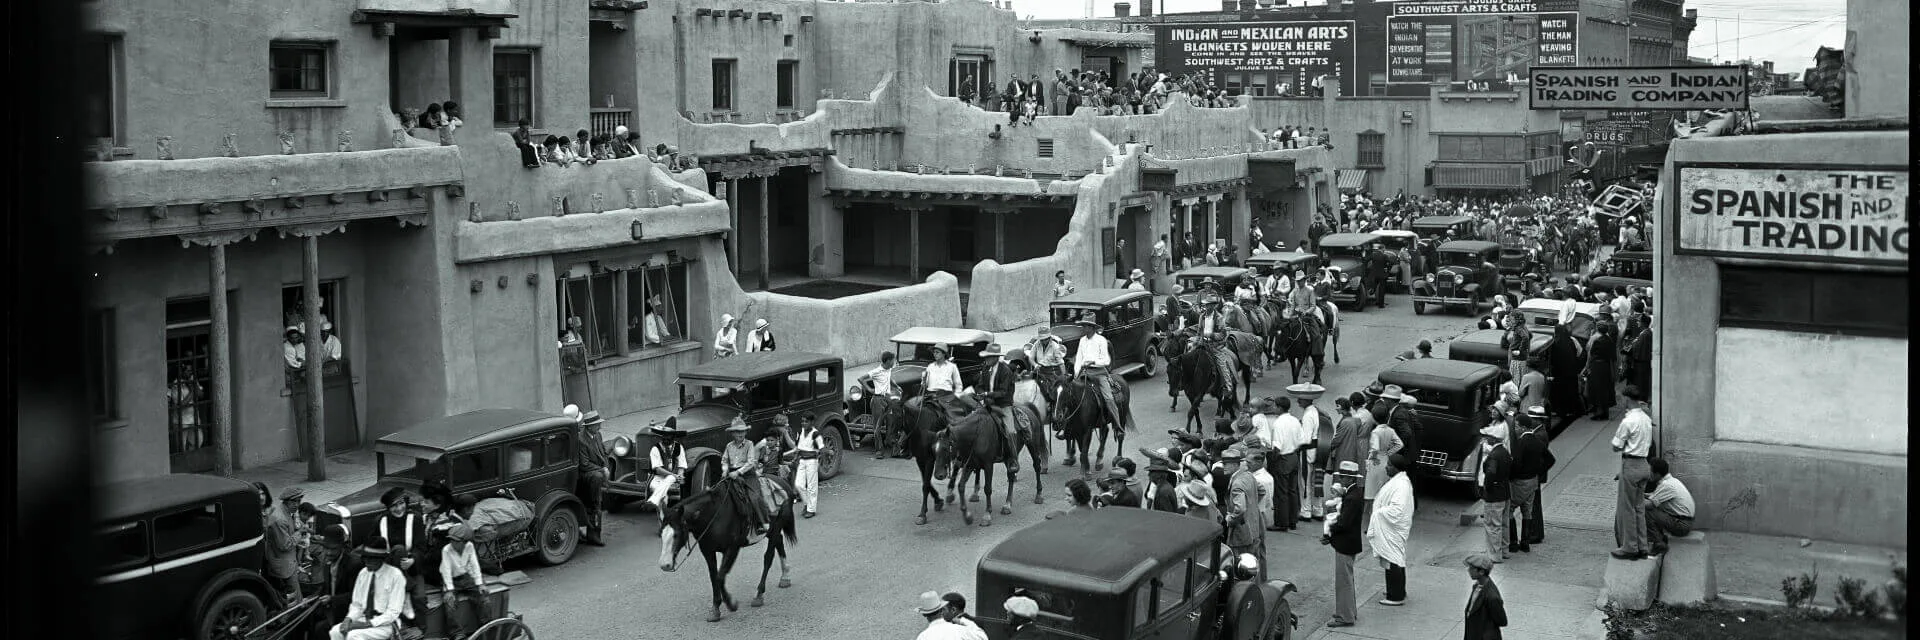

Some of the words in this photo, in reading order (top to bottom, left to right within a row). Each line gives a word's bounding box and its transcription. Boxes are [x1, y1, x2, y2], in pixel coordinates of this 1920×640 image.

[1398, 5, 1459, 14] SOUTHWEST
[1461, 4, 1489, 12] ARTS
[1491, 4, 1499, 12] &
[1500, 3, 1537, 12] CRAFTS
[1390, 22, 1409, 30] WATCH
[1410, 22, 1423, 30] THE
[1541, 20, 1567, 28] WATCH
[1240, 27, 1303, 40] MEXICAN
[1307, 26, 1348, 39] ARTS
[1541, 31, 1556, 40] THE
[1556, 31, 1572, 40] MAN
[1183, 42, 1248, 52] BLANKETS
[1251, 41, 1292, 51] WOVEN
[1296, 41, 1332, 51] HERE
[1540, 43, 1572, 52] WEAVING
[1184, 58, 1244, 66] SOUTHWEST
[1247, 58, 1272, 66] ARTS
[1276, 57, 1284, 65] &
[1288, 57, 1329, 65] CRAFTS
[1391, 57, 1402, 65] AT
[1403, 57, 1422, 65] WORK
[1539, 55, 1576, 64] BLANKETS
[1535, 73, 1619, 87] SPANISH
[1626, 75, 1662, 85] AND
[1670, 72, 1743, 88] INDIAN
[1536, 87, 1617, 101] TRADING
[1631, 89, 1745, 103] COMPANY
[1586, 132, 1624, 141] DRUGS
[1828, 174, 1896, 190] THE
[1690, 189, 1843, 220] SPANISH
[1850, 198, 1893, 220] AND
